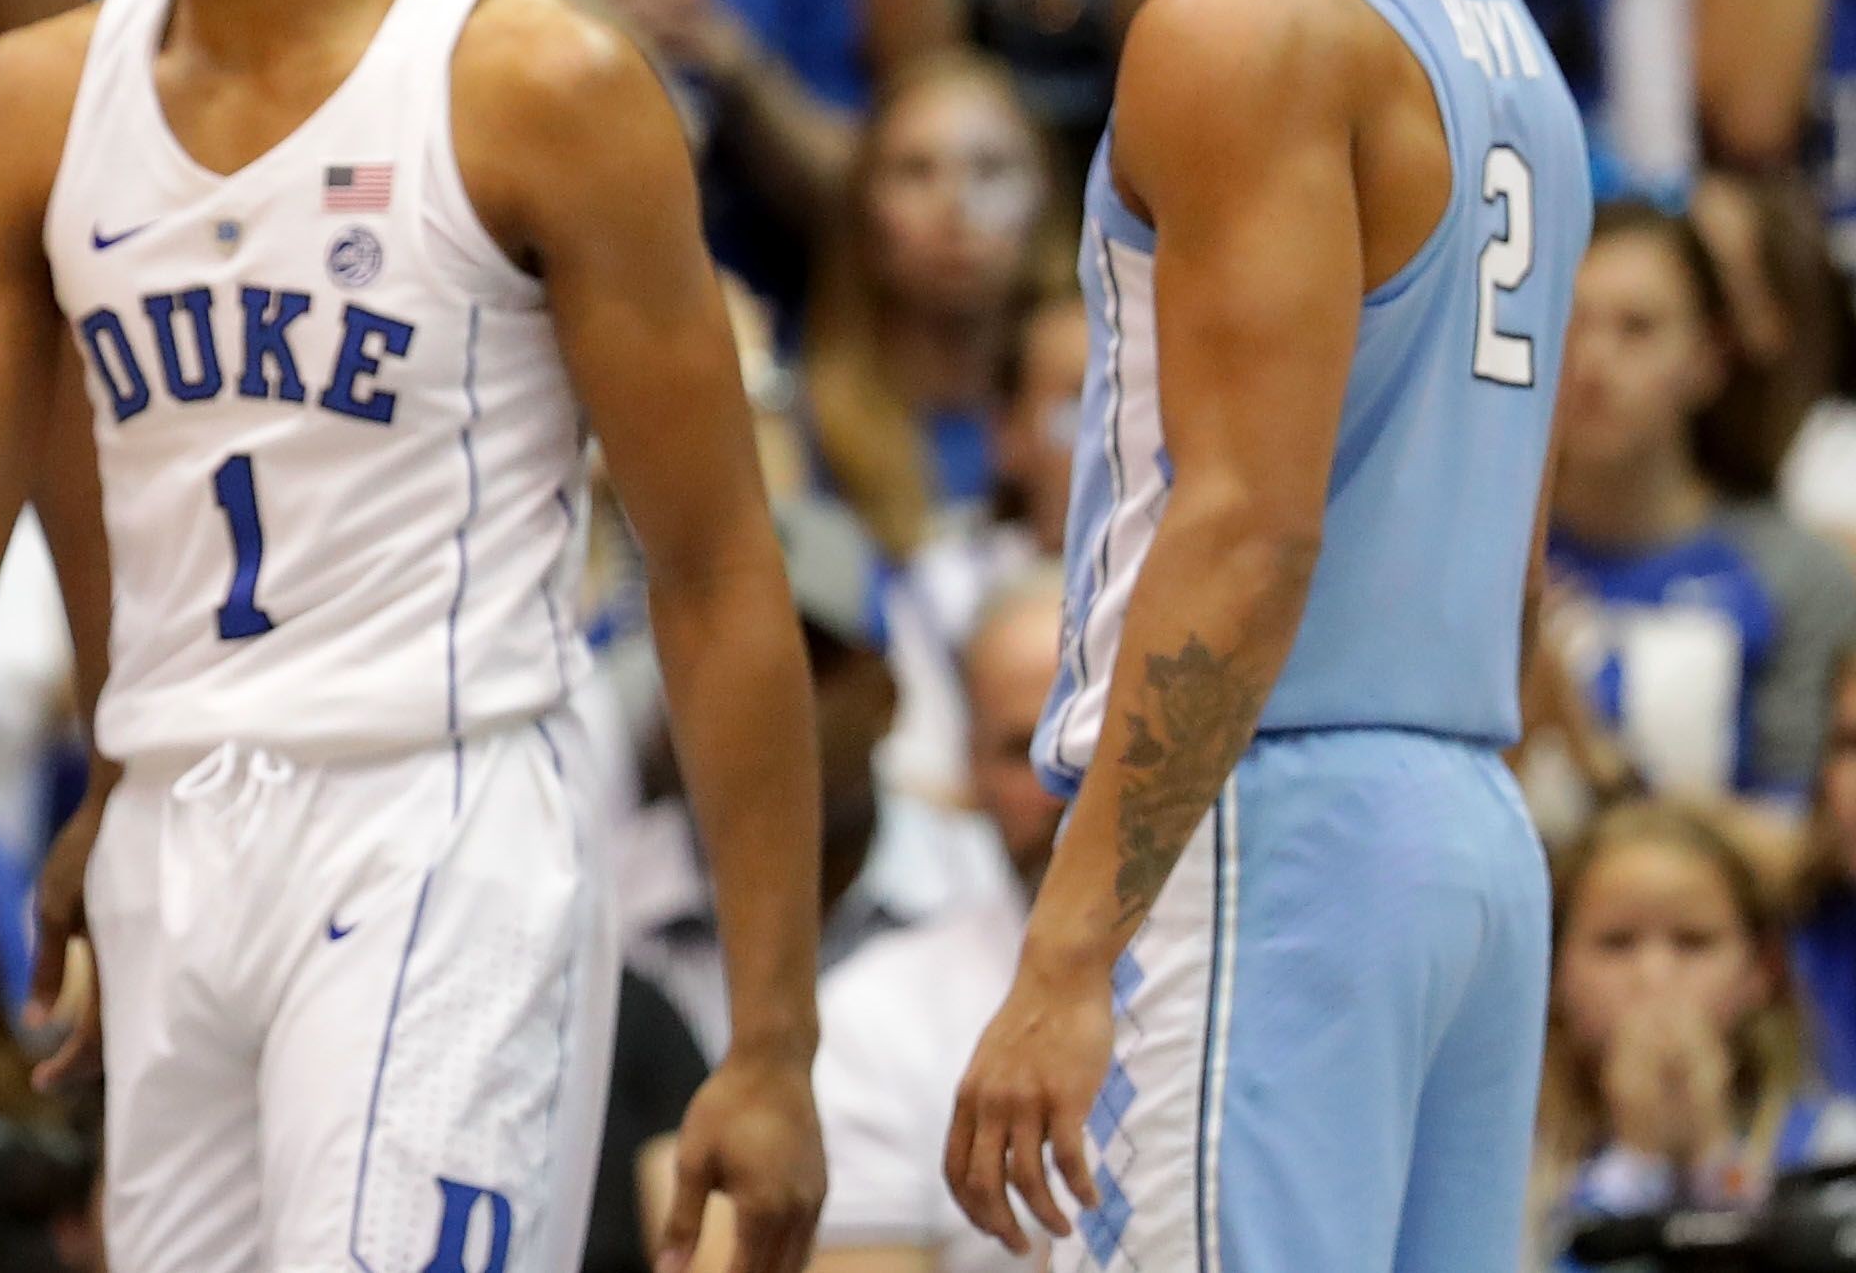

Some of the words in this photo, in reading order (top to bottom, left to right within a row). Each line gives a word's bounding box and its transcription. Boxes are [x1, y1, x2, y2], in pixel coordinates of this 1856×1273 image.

[80, 284, 416, 427] DUKE
[1470, 143, 1537, 390] 2
[211, 452, 279, 642] 1
